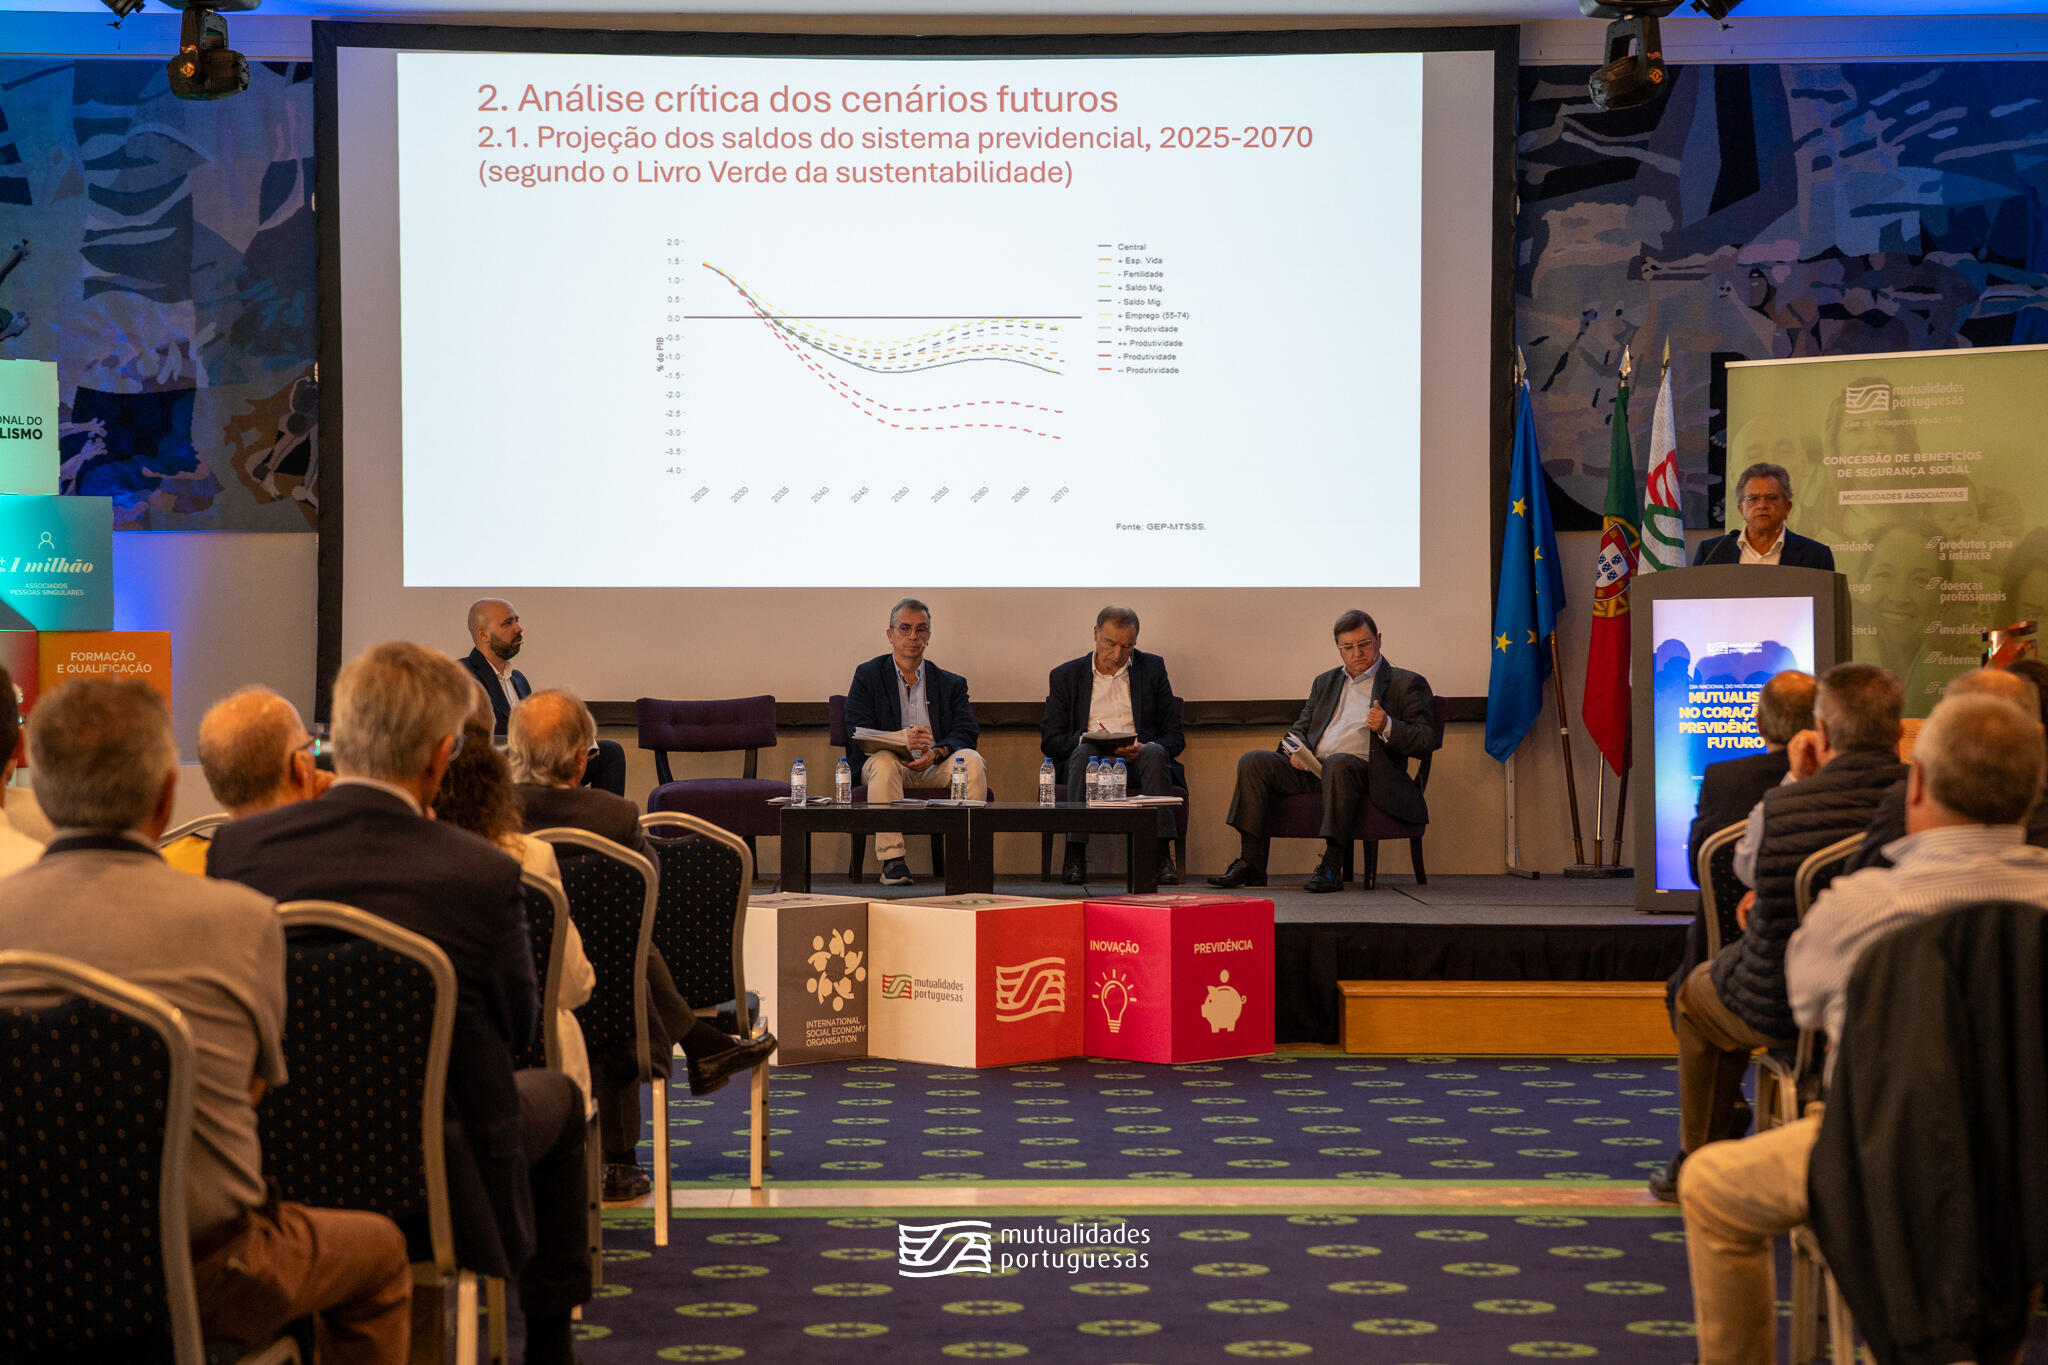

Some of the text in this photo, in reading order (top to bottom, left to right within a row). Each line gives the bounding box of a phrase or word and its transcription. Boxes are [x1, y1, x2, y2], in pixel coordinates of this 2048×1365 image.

[477, 83, 1119, 113] 2. Análise crítica dos cenários futuros
[477, 125, 1313, 154] 2.1. Projeção dos saldos do sistema previdencial, 2025-2070
[479, 160, 1073, 188] (segundo o Livro Verde da sustentabilidade)
[667, 238, 680, 246] 2.0
[1118, 243, 1146, 251] Central
[1125, 257, 1143, 265] Esp.
[1125, 312, 1160, 320] Emprego
[1162, 312, 1190, 320] (55-74)
[1125, 325, 1178, 333] Produtividade
[656, 337, 664, 351] PIB
[1129, 339, 1183, 347] Produtividade
[656, 353, 664, 362] do
[1892, 382, 1965, 396] mutualidades
[1892, 396, 1965, 410] portuguesas
[26, 416, 43, 425] DO
[0, 427, 43, 440] LISMO
[1823, 450, 1982, 465] CONCESSÃO DE BENEFÍCIOS
[1837, 465, 1971, 478] DE SEGURANÇA SOCIAL
[690, 486, 1070, 504] 2025 2030 2035 2040 2045 2050 2055 2060 2065 2070
[1842, 490, 1964, 501] MODALIDADES ASSOCIATIVAS
[1116, 523, 1206, 532] Fonte: GEP-MTSSS.
[1829, 540, 1874, 552] ernidade
[1939, 539, 2013, 552] produtos para
[1939, 550, 1991, 561] a infância
[24, 557, 94, 574] milhão
[1939, 581, 1983, 592] doenças
[1940, 591, 2007, 604] profissionais
[70, 650, 136, 663] FORMAÇÃO
[1938, 653, 1981, 665] reforma
[57, 662, 152, 675] E QUALIFICAÇÃO
[1678, 707, 1701, 719] NO
[1707, 736, 1766, 749] FUTURO
[1089, 939, 1139, 955] INOVAÇÃO
[1193, 938, 1253, 954] PREVIDÊNCIA
[914, 978, 964, 991] mutualidades
[914, 990, 964, 1002] portuguesas
[806, 1017, 860, 1029] INTERNATIONAL
[806, 1025, 866, 1038] SOCIAL ECONOMY
[806, 1035, 857, 1047] ORGANISATION
